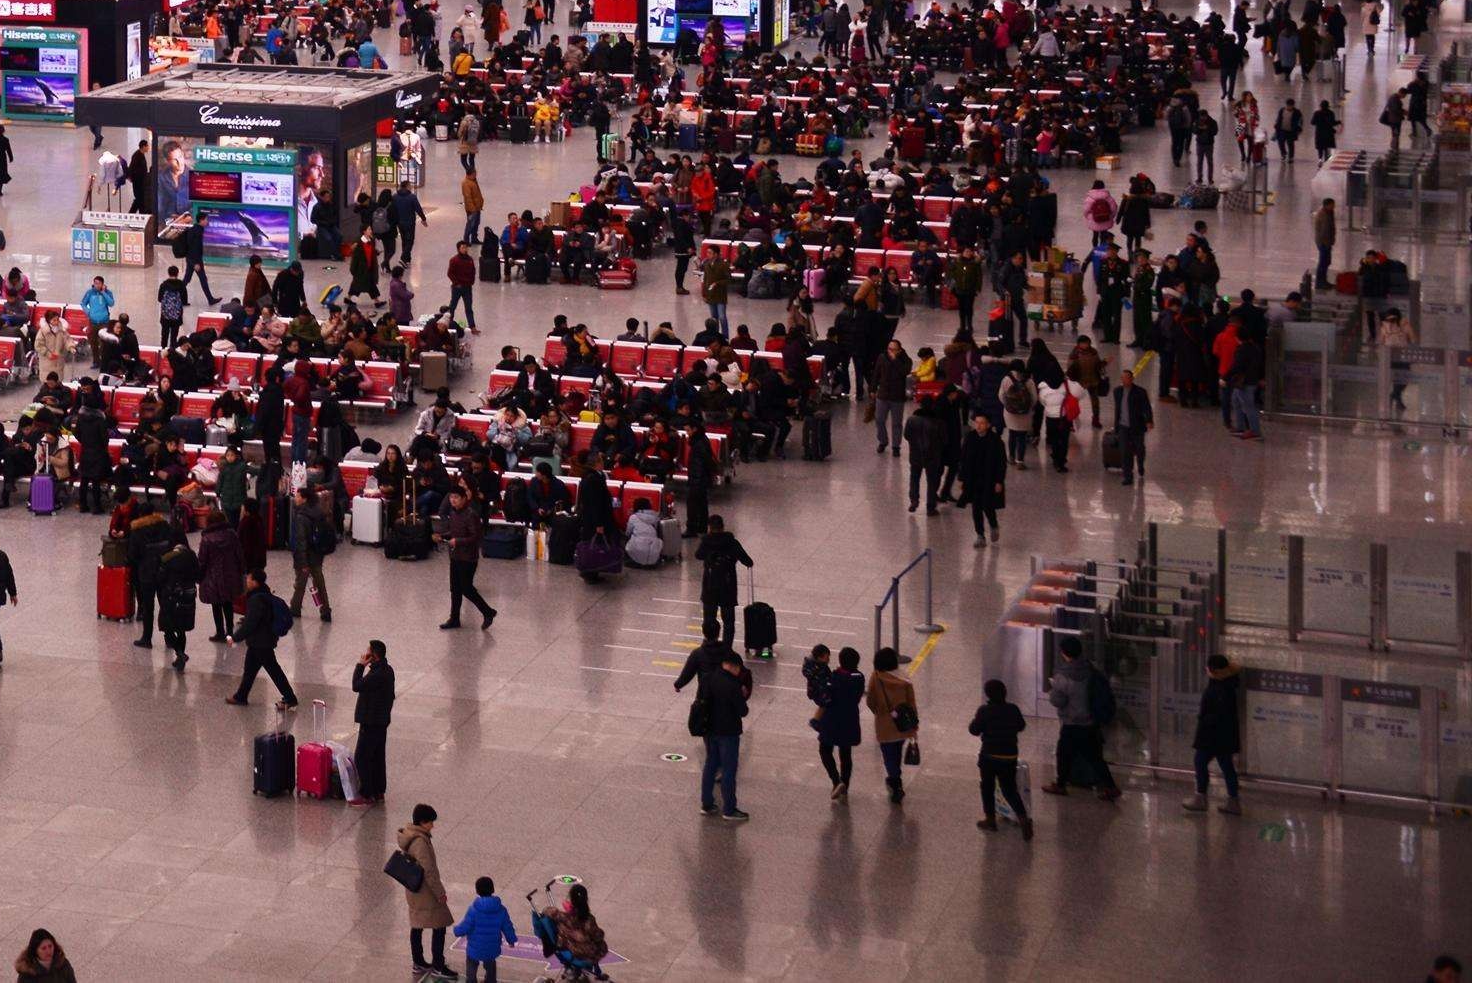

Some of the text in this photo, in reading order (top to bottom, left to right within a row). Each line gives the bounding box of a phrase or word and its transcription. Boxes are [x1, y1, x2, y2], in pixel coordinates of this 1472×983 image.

[3, 30, 47, 41] Hisense
[198, 104, 282, 127] Camicissima
[195, 148, 253, 162] Hisense
